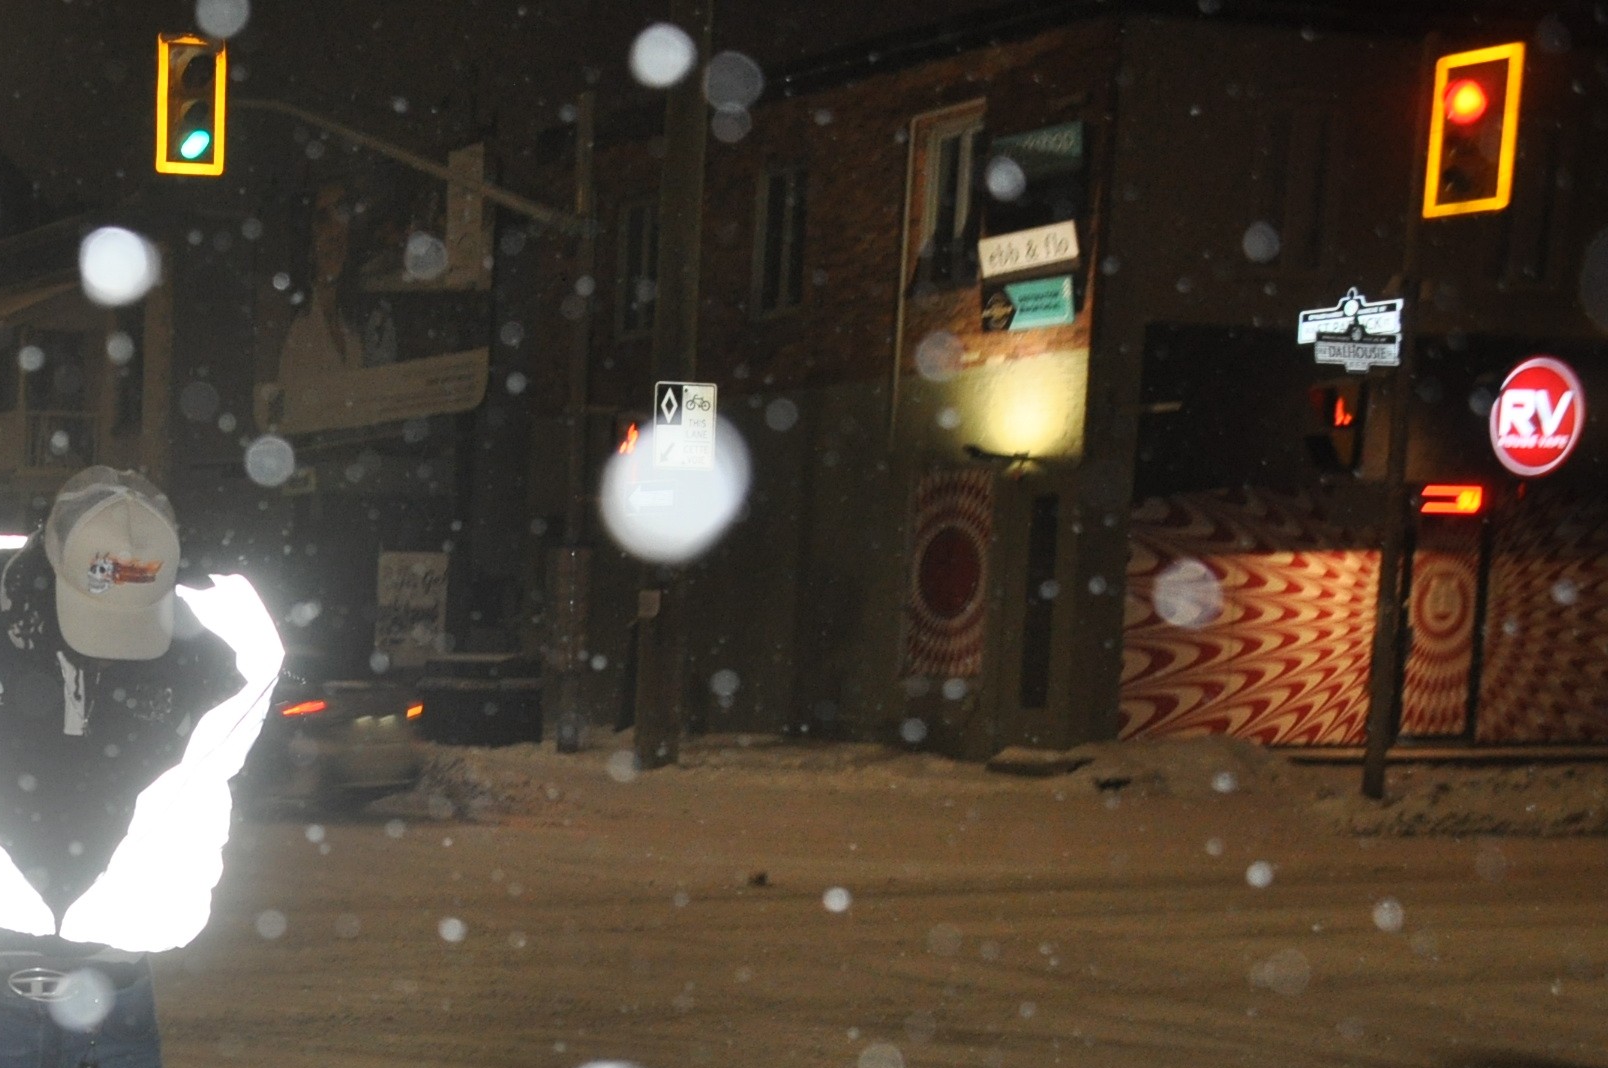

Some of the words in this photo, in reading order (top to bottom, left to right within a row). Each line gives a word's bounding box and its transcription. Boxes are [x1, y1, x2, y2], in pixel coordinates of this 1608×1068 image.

[1328, 343, 1386, 359] DALHOUSIE
[1498, 388, 1574, 437] RV
[689, 418, 707, 429] THIS
